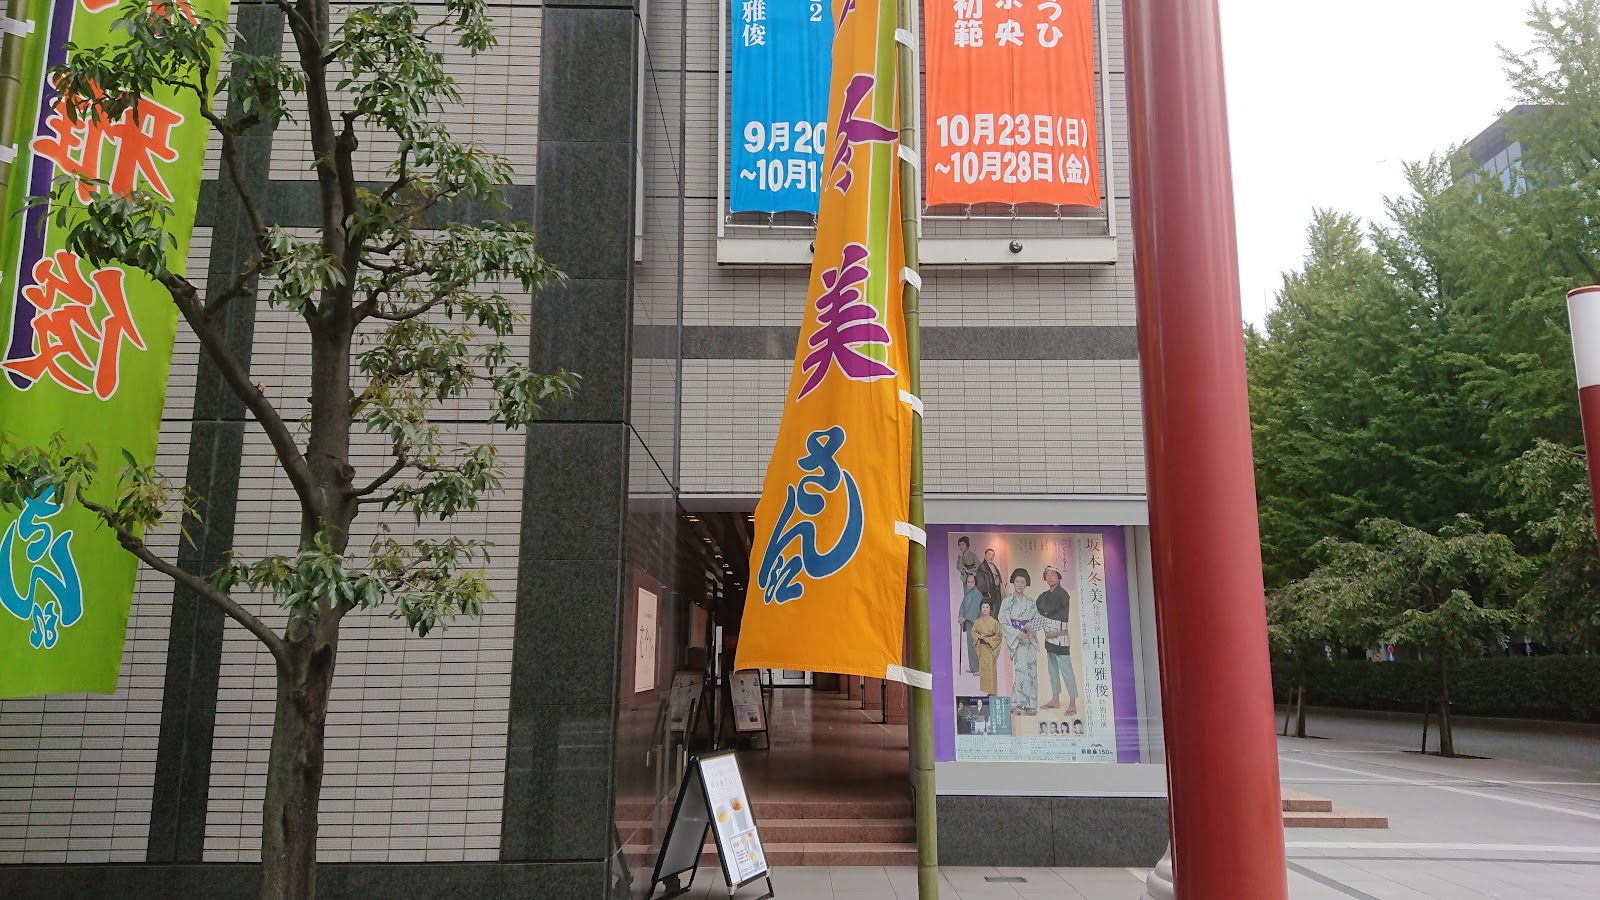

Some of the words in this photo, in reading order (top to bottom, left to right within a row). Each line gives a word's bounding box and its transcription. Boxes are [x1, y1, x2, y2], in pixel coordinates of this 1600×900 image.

[742, 0, 767, 47] 雅俊
[809, 0, 823, 22] 2
[739, 158, 824, 193] ~10月1
[1085, 537, 1103, 604] 坂本冬美
[1092, 634, 1109, 698] 中村雅俊
